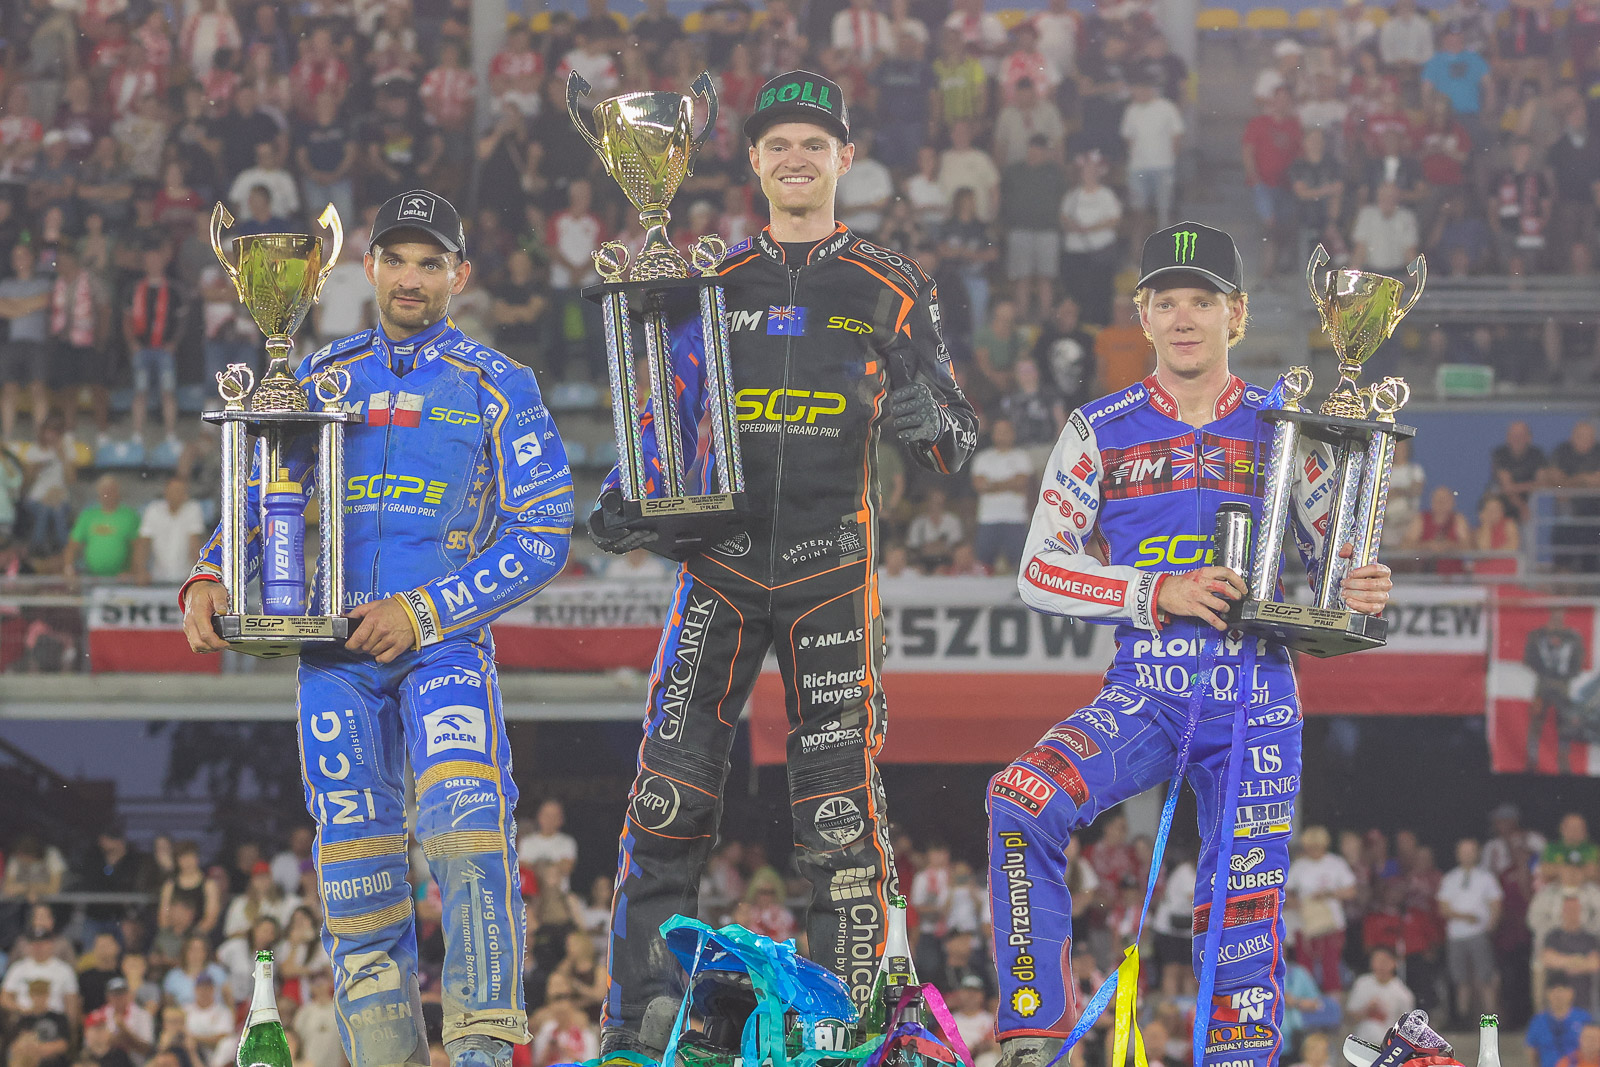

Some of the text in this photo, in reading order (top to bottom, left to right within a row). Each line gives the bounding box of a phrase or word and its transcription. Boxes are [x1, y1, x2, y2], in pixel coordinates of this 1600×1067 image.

[759, 82, 832, 112] BOLL
[403, 209, 428, 218] ORLEN
[827, 316, 874, 334] SGP
[736, 388, 847, 424] SGP
[1153, 393, 1174, 414] ANLAS
[1226, 385, 1242, 407] ANLAS
[428, 406, 481, 426] SGP
[787, 424, 819, 436] GRAND
[819, 427, 841, 438] PRIX
[1111, 457, 1167, 485] FIM
[1056, 469, 1099, 511] BETARD
[387, 502, 417, 515] GRAND
[417, 506, 437, 518] PRIX
[645, 498, 685, 511] SGP
[1042, 488, 1088, 530] CSO
[274, 519, 290, 581] verva
[445, 530, 469, 550] 95
[782, 539, 834, 562] EASTERN
[792, 547, 829, 565] POINT
[437, 553, 525, 616] MCG
[492, 579, 525, 603] Logistics
[1261, 603, 1303, 616] SGP
[244, 617, 285, 628] SGP
[815, 627, 865, 648] ANLAS
[659, 594, 715, 742] GARCAREK
[802, 664, 866, 689] Richard
[419, 672, 482, 696] verva
[811, 685, 863, 705] Hayes
[1101, 690, 1136, 708] ATPI
[347, 719, 364, 766] Logistics
[433, 733, 477, 745] ORLEN
[801, 727, 863, 748] MOTOREX
[812, 744, 819, 753] of
[818, 737, 864, 752] Switzerland
[311, 710, 370, 826] MCG
[1248, 744, 1283, 774] US
[445, 778, 480, 789] ORLEN
[997, 768, 1051, 801] AMD
[446, 787, 497, 816] Team
[637, 791, 670, 815] ATPI
[1249, 825, 1270, 837] plc
[324, 871, 393, 901] PROFBUD
[834, 906, 849, 955] Flooring
[461, 903, 475, 989] Insurance Broker
[482, 887, 502, 1001] Jörg Grohmann
[836, 957, 849, 972] by
[349, 1000, 413, 1031] ORLEN
[371, 1029, 399, 1042] OIL
